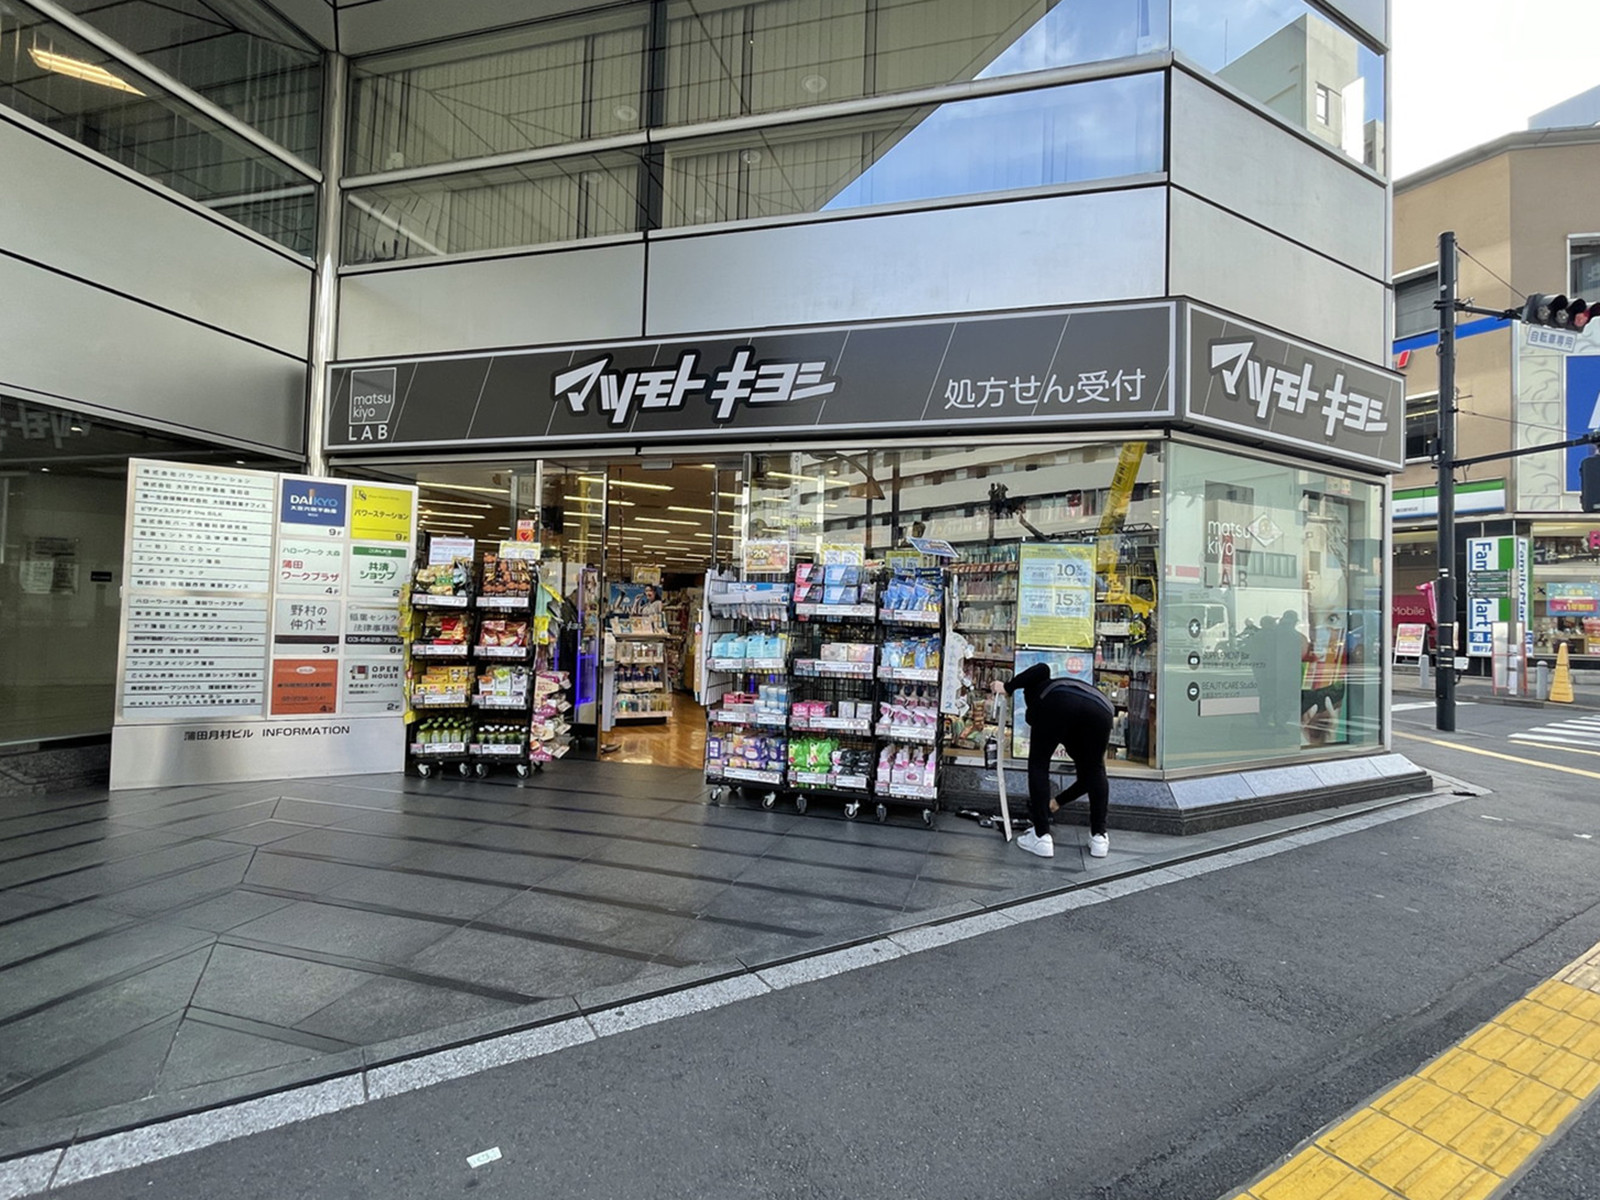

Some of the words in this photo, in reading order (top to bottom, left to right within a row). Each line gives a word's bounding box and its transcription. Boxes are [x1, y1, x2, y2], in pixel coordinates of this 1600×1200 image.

[554, 350, 837, 425] マツモトキヨシ
[943, 367, 1147, 411] 処方せん受付
[1211, 340, 1389, 438] マツモトキヨシ
[353, 393, 392, 405] matsu
[353, 405, 376, 420] kiyo
[348, 424, 388, 441] LAB
[290, 490, 338, 507] DAIKYO
[1207, 519, 1250, 540] matsu
[282, 547, 324, 556] ハローワーク
[282, 560, 303, 569] 蒲田
[368, 562, 389, 571] 共済
[281, 570, 339, 582] ワークプラザ
[360, 570, 396, 580] ショップ
[1203, 566, 1248, 591] LAB
[290, 604, 328, 617] 野村の
[184, 729, 253, 742] 蒲田月村ビル
[262, 725, 351, 738] INFORMATION
